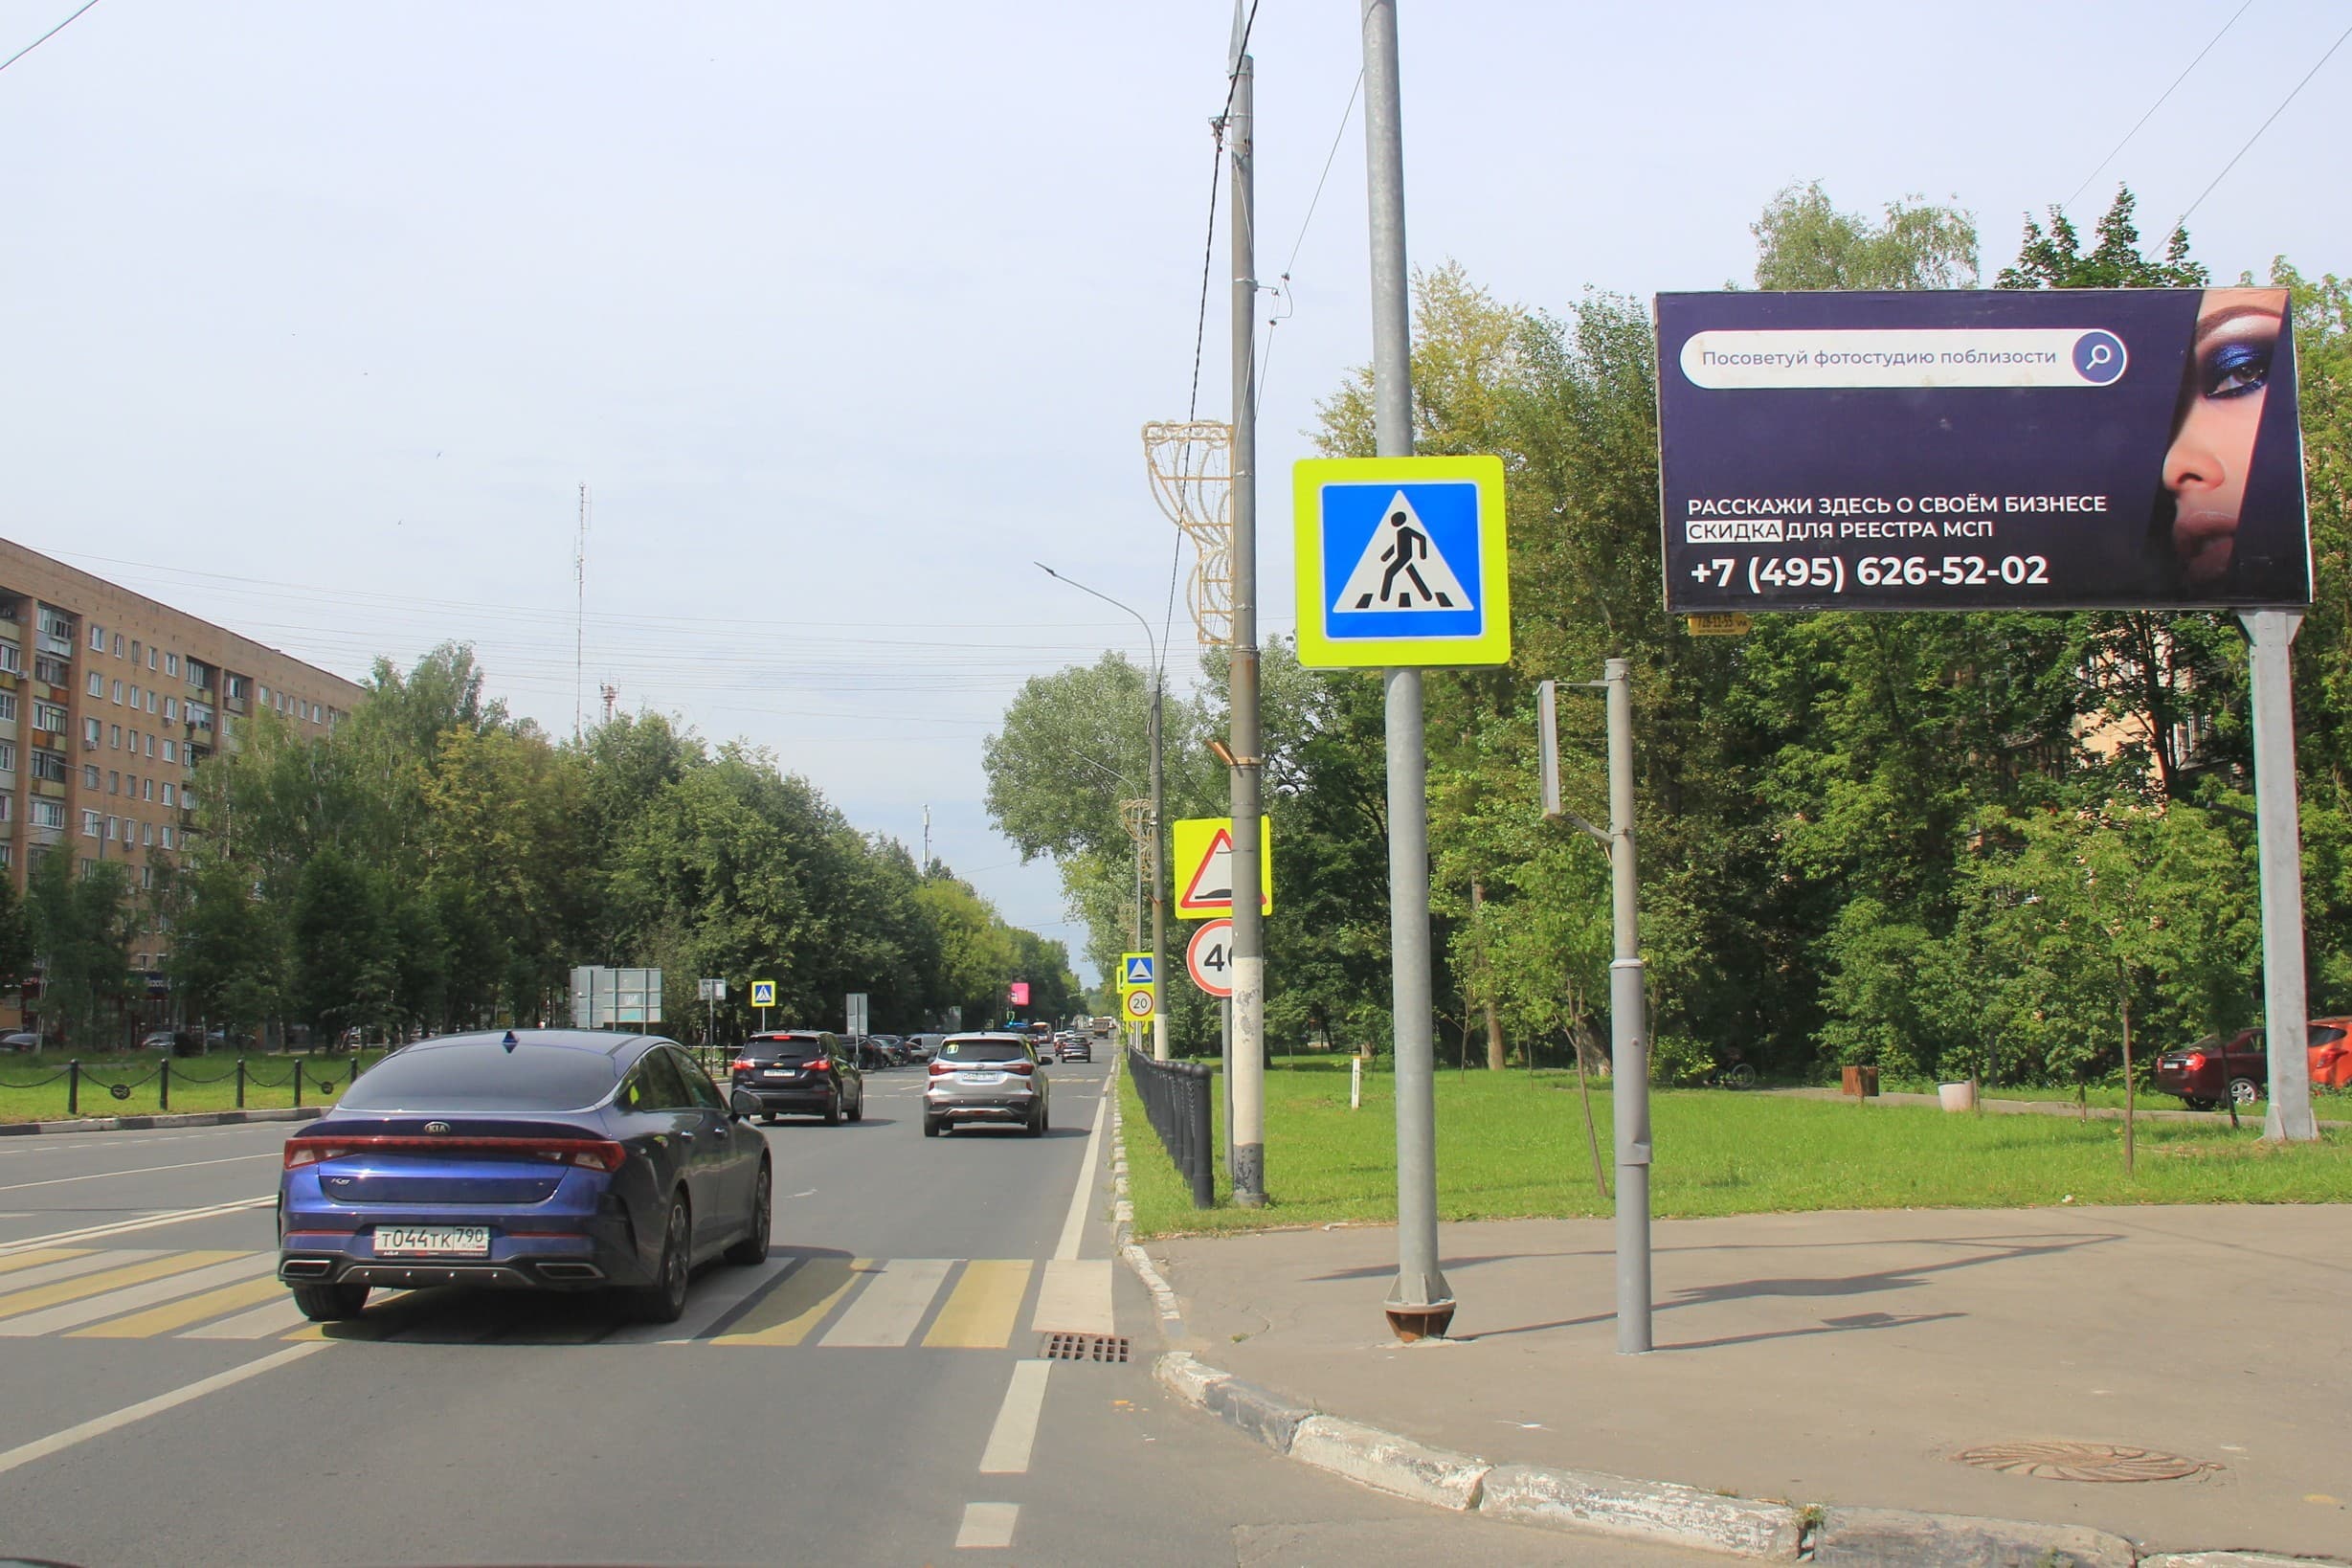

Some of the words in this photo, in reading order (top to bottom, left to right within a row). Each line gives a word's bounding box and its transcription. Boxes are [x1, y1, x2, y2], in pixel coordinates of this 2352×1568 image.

[1702, 350, 1808, 369] Посоветуй
[1814, 350, 1935, 369] фотостудию
[1940, 349, 2056, 365] поблизости
[1688, 498, 1812, 516] РАССКАЖИ
[1819, 498, 1892, 517] ЗДЕСЬ
[1896, 497, 1914, 513] О
[1918, 493, 1998, 513] СВОЁМ
[2005, 496, 2108, 512] БИЗНЕСЕ
[1689, 523, 1781, 541] СКИДКА
[1785, 522, 1833, 542] ДЛЯ
[1840, 521, 1938, 538] РЕЕСТРА
[1943, 521, 1994, 538] МСП
[1691, 558, 1736, 588] +7
[1748, 556, 1845, 594] (495)
[1856, 555, 2050, 586] 626-52-02
[1203, 944, 1233, 972] 4
[1132, 997, 1148, 1009] 20
[428, 1124, 447, 1133] KIA
[456, 1228, 484, 1243] 790
